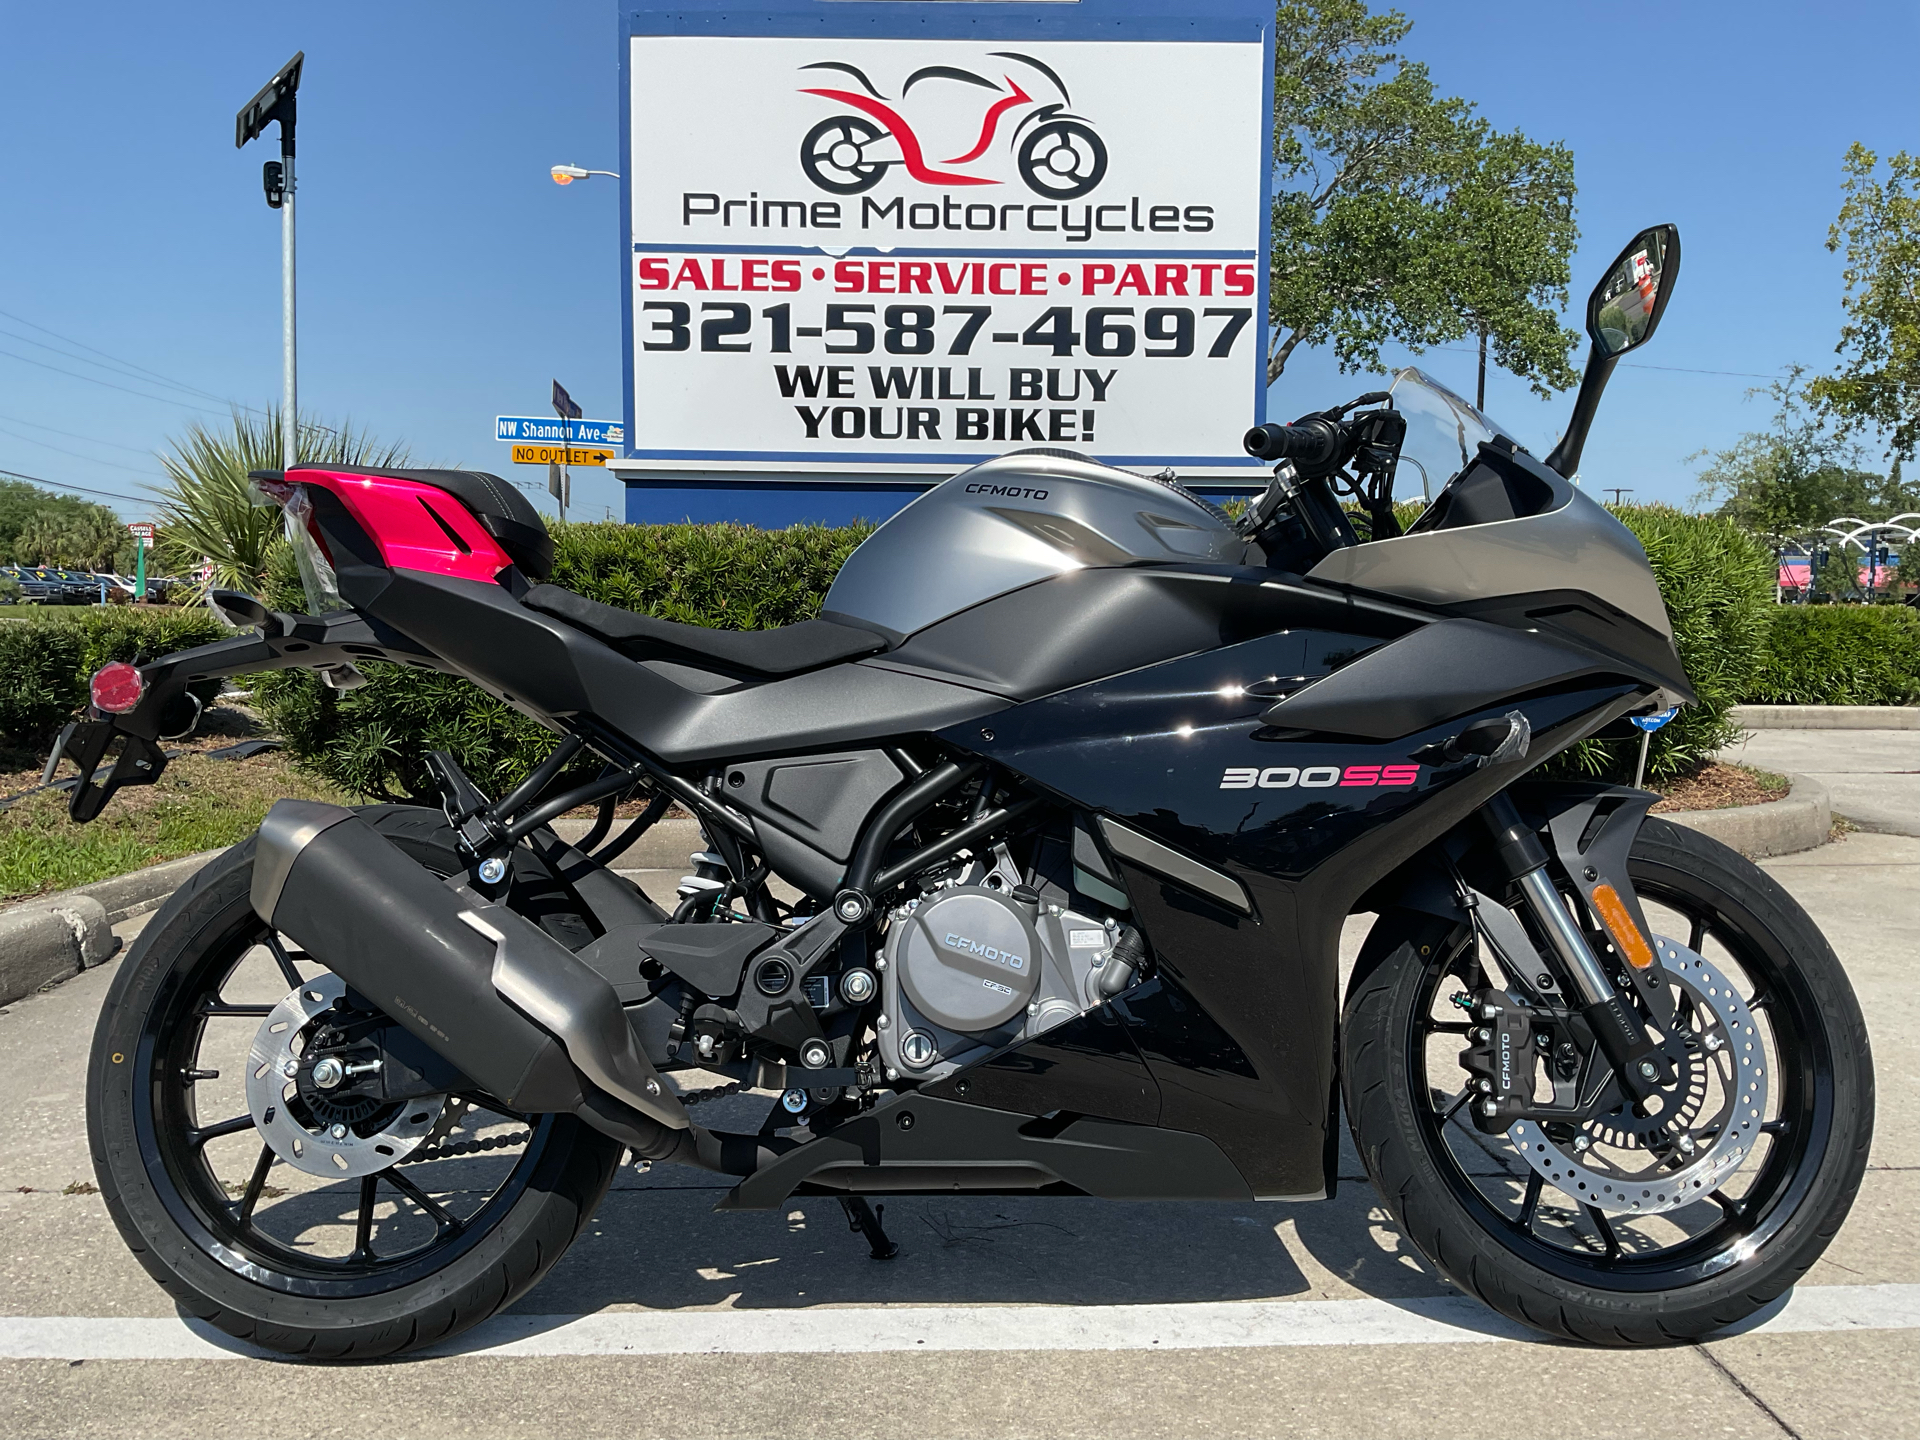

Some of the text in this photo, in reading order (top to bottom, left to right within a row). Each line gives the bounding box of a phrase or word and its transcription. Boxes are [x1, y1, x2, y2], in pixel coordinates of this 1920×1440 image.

[683, 191, 1215, 242] Prime Motorcycles
[639, 257, 1255, 297] SALES SERVICE PARTS
[642, 300, 1253, 359] 321-587-4697
[773, 364, 1118, 402] WE WILL BUY
[499, 420, 600, 441] NW Shannon Ave
[793, 405, 1095, 442] YOUR BIKE!
[516, 448, 589, 463] NO OUTLET
[964, 483, 1049, 501] CFMOTO
[1219, 764, 1421, 789] 300SS
[944, 932, 1024, 970] CFMOTO
[1501, 1033, 1511, 1090] CFMOTO
